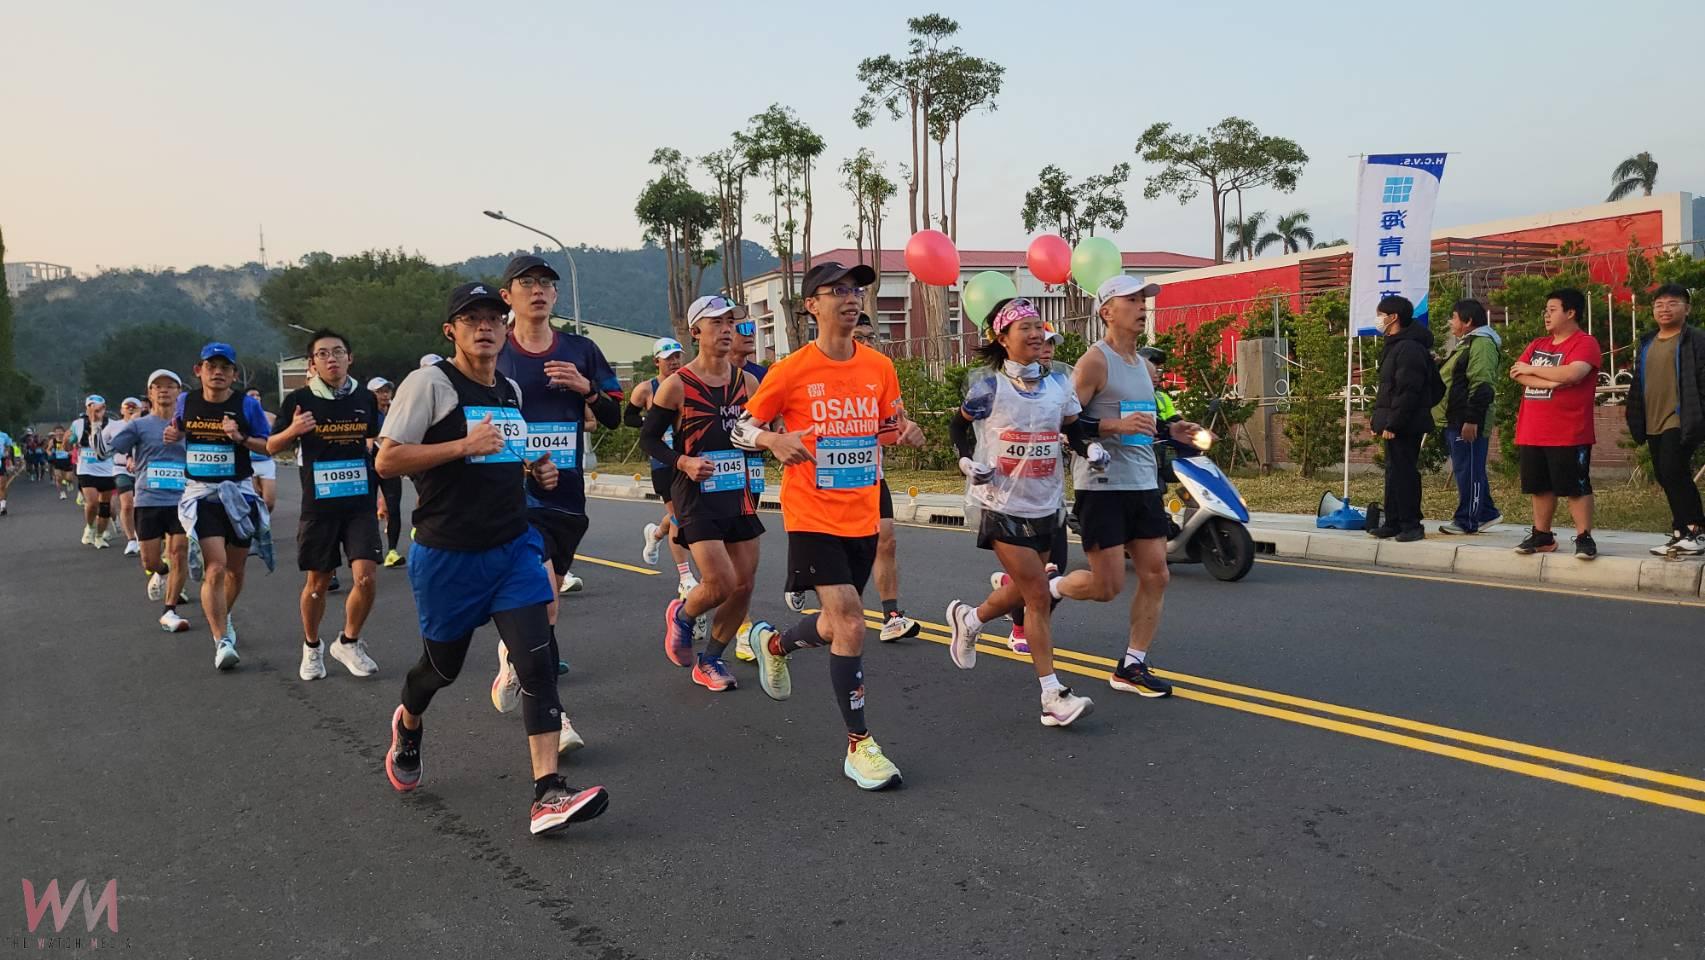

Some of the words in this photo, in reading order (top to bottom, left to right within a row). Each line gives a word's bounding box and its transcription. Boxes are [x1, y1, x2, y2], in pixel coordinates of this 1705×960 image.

[811, 397, 879, 422] OSAKA
[315, 423, 368, 433] KAOHSIUN
[526, 436, 569, 448] 10044
[1006, 444, 1051, 457] 40285
[193, 454, 228, 462] 12059
[827, 450, 873, 465] 10892
[715, 460, 741, 473] 1045
[322, 470, 361, 481] 10893
